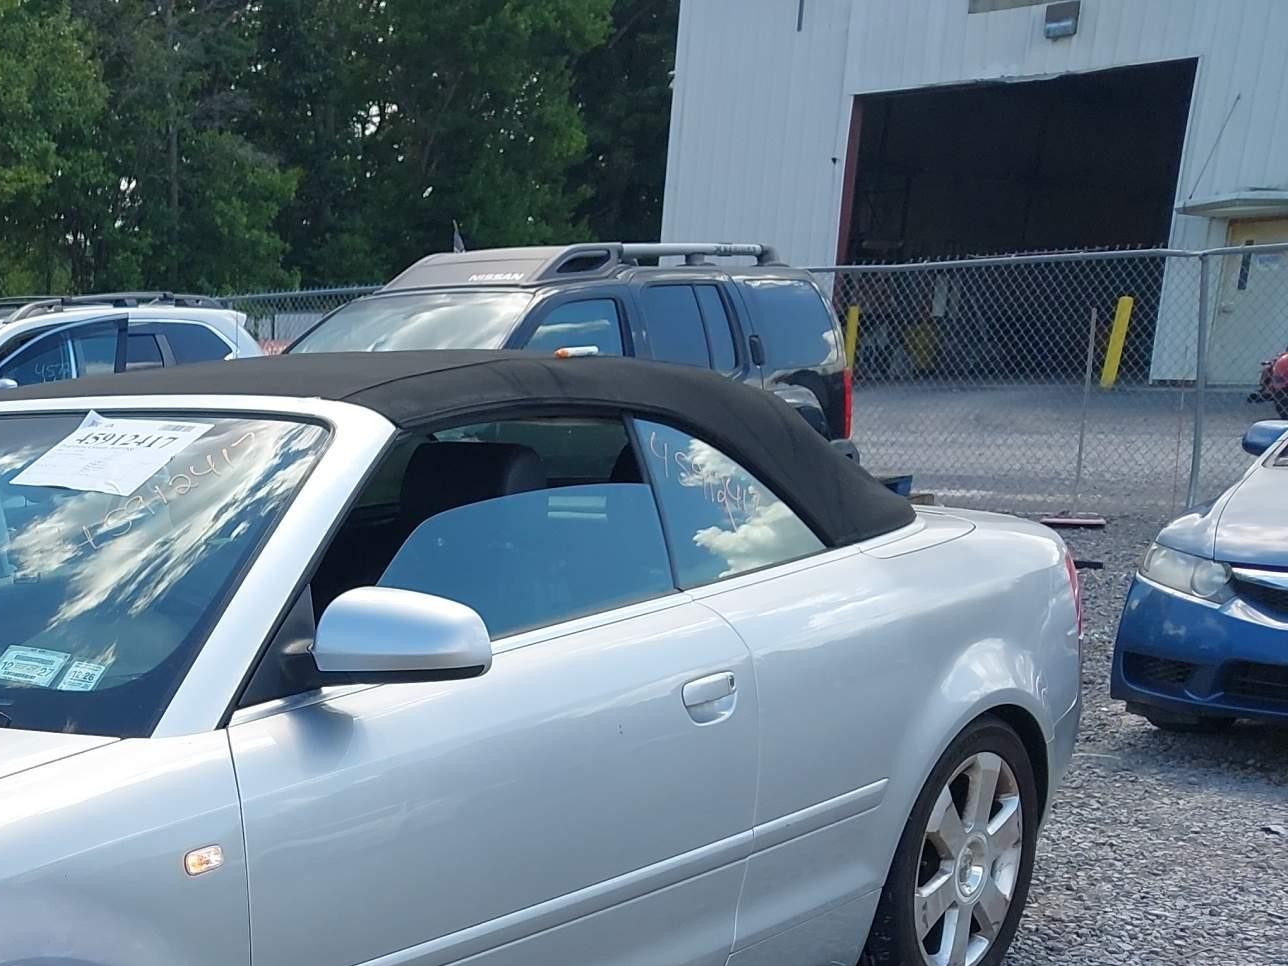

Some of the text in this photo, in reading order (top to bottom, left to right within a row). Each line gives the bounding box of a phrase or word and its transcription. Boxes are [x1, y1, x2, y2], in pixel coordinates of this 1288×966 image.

[468, 272, 524, 282] NISSAN
[75, 432, 180, 449] 45912417
[0, 661, 14, 671] 12
[36, 667, 55, 677] 27
[83, 672, 96, 681] 26
